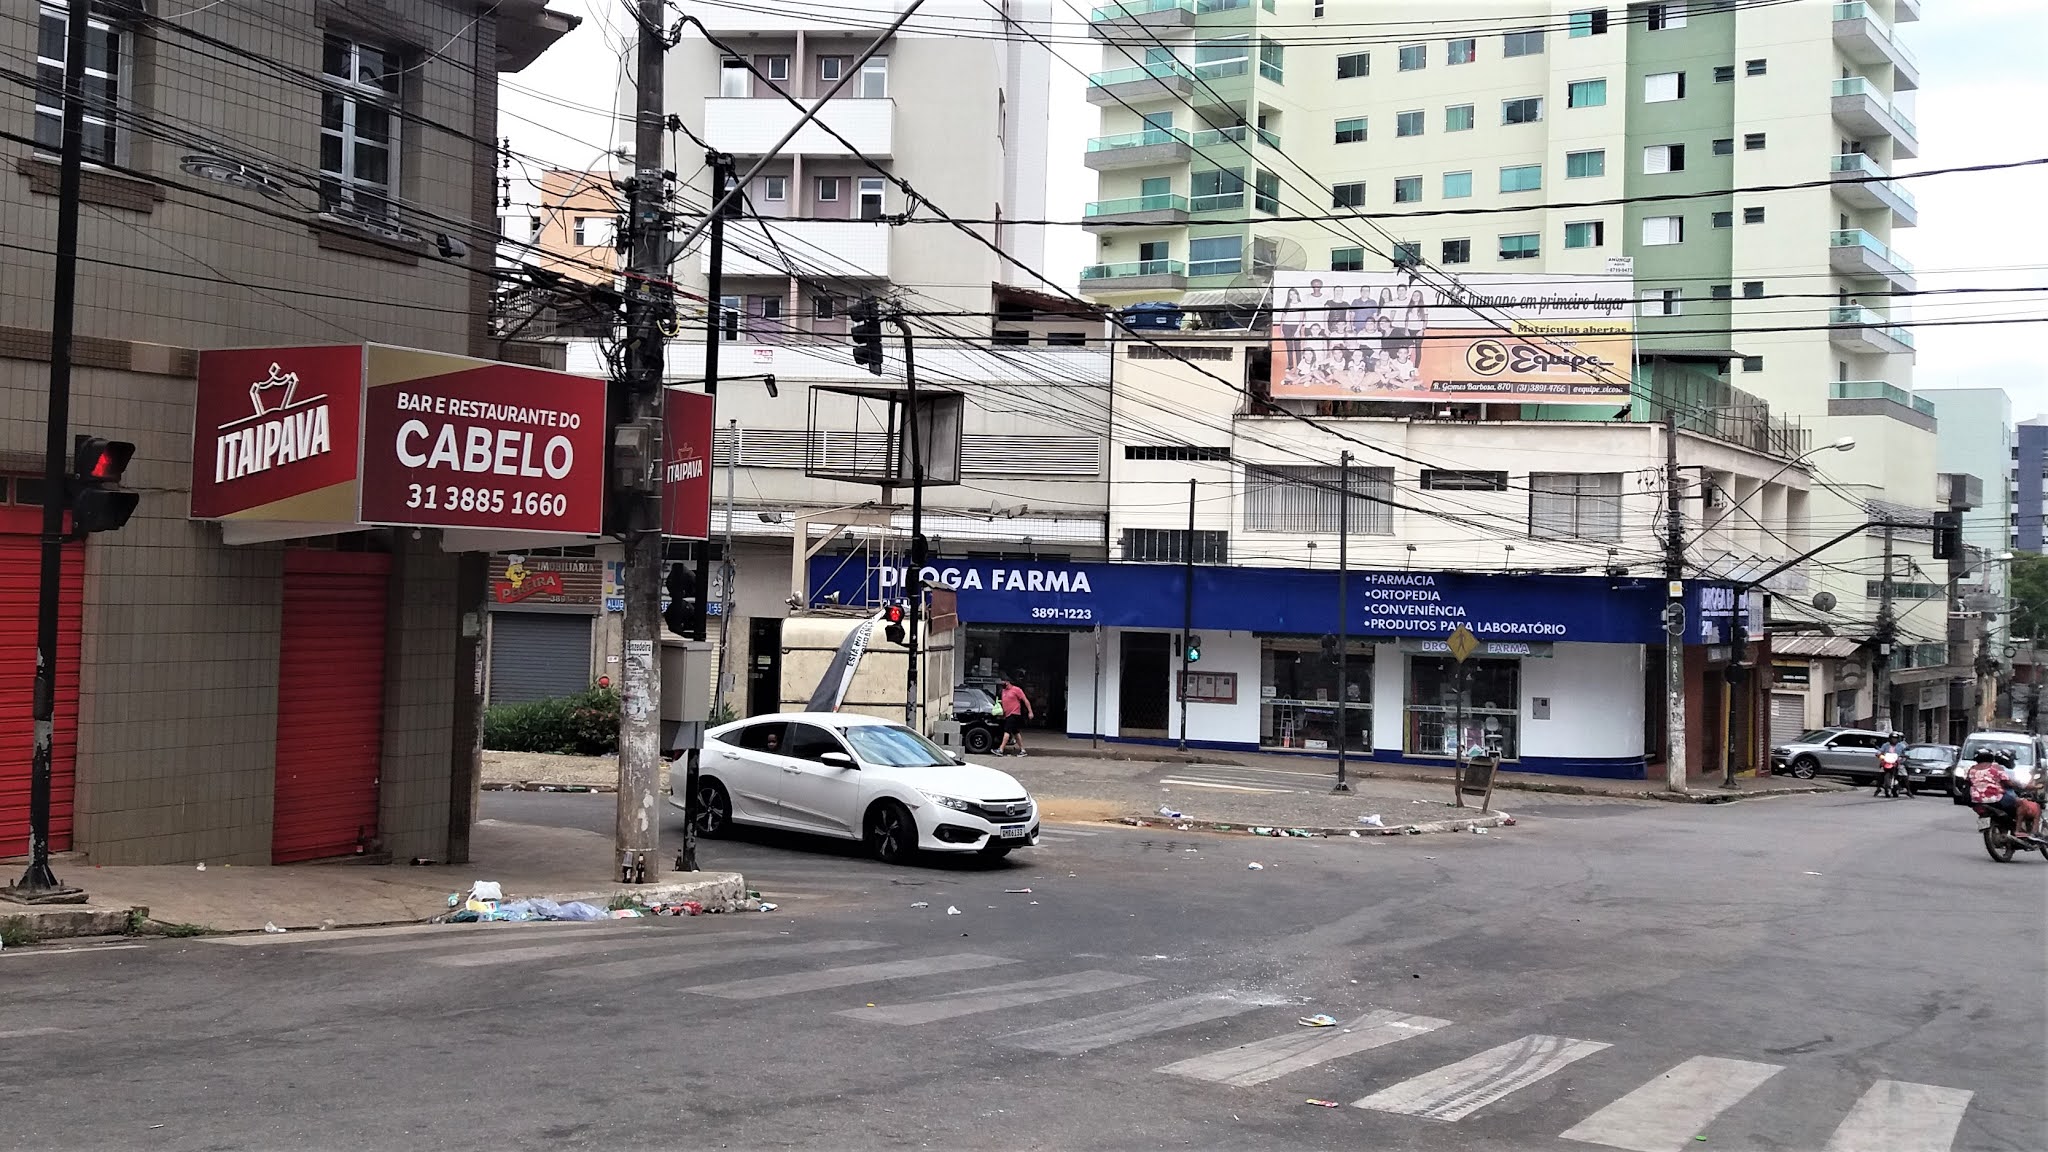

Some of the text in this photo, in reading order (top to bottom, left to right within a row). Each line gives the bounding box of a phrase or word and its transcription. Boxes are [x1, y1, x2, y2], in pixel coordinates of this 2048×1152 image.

[1468, 291, 1516, 309] humano
[1519, 295, 1537, 310] em
[1538, 292, 1590, 315] primeiro
[1593, 293, 1627, 316] lugar
[1517, 323, 1627, 335] Matrículas abertas
[1466, 383, 1497, 392] Barbosa,
[397, 392, 581, 430] BAR E RESTAURANTE DO
[215, 404, 331, 484] ITAIPAVA
[396, 419, 574, 480] CABELO
[666, 459, 703, 484] ITAIPAVA
[406, 483, 567, 517] 31 3885 1660
[537, 559, 595, 573] IMOBILIÁRIA
[992, 569, 1092, 593] FARMA
[1371, 573, 1436, 587] FARMÁCIA
[1370, 589, 1441, 601] ORTOPEDIA
[606, 600, 624, 609] ALUG
[1370, 603, 1467, 617] CONVENIÊNCIA
[1031, 607, 1092, 620] 3891-1223
[1370, 618, 1437, 631] PRODUTOS
[1477, 620, 1567, 635] LABORATÓRIO
[1487, 642, 1531, 654] FARMA
